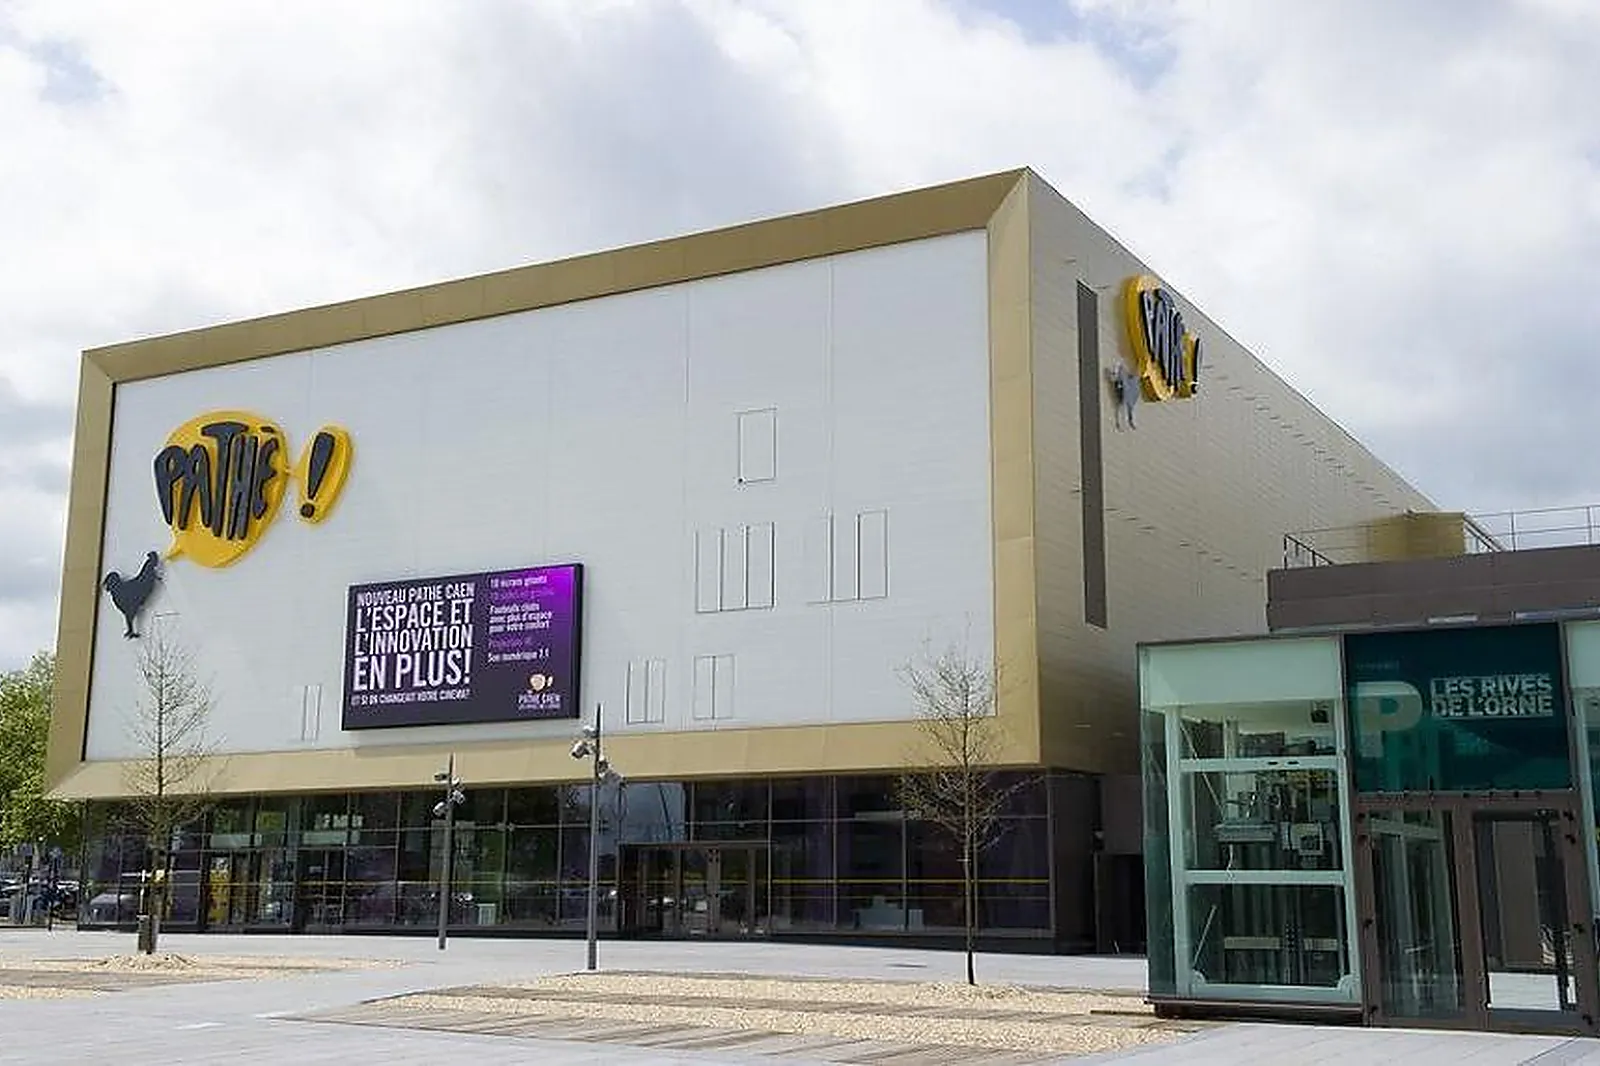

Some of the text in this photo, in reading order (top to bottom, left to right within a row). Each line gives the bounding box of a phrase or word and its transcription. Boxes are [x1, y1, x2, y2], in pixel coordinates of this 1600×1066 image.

[356, 588, 406, 607] NOUVEAU
[445, 582, 475, 600] CAEN
[356, 598, 475, 633] L'ESPACE ET
[354, 624, 474, 655] L'INNOVATION
[353, 649, 471, 691] EN PLUS!
[1430, 675, 1553, 699] LES RIVES
[1357, 680, 1423, 757] P
